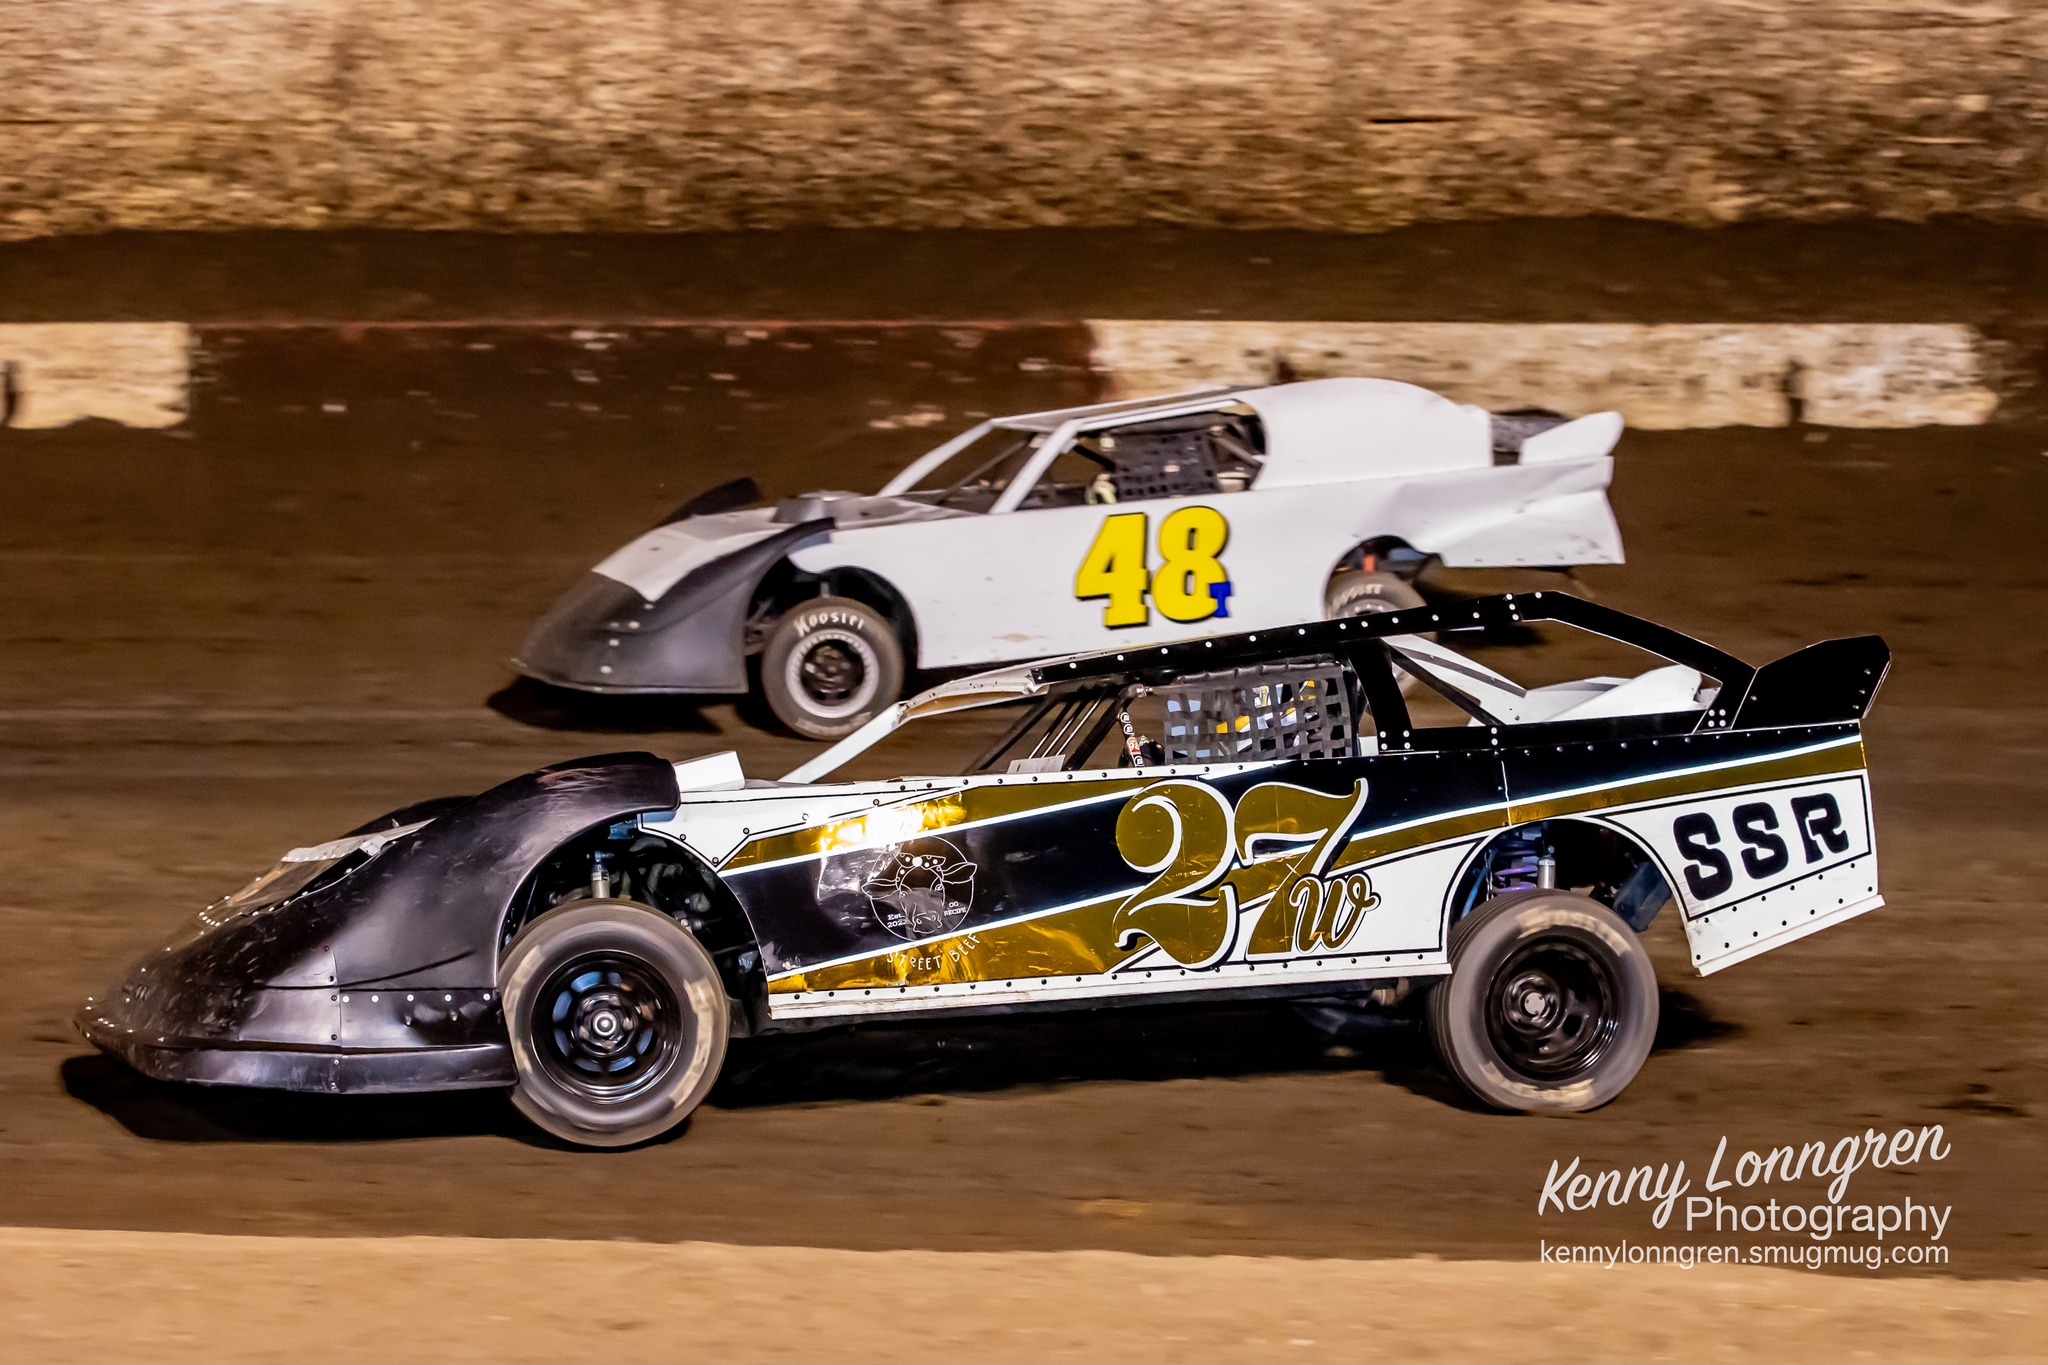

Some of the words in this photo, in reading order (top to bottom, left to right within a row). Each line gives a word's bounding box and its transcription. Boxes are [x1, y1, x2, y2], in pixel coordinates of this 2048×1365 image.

[1673, 792, 1850, 901] SSR
[943, 906, 967, 917] RECIPE
[886, 951, 942, 971] STREET
[948, 932, 981, 962] BEEF
